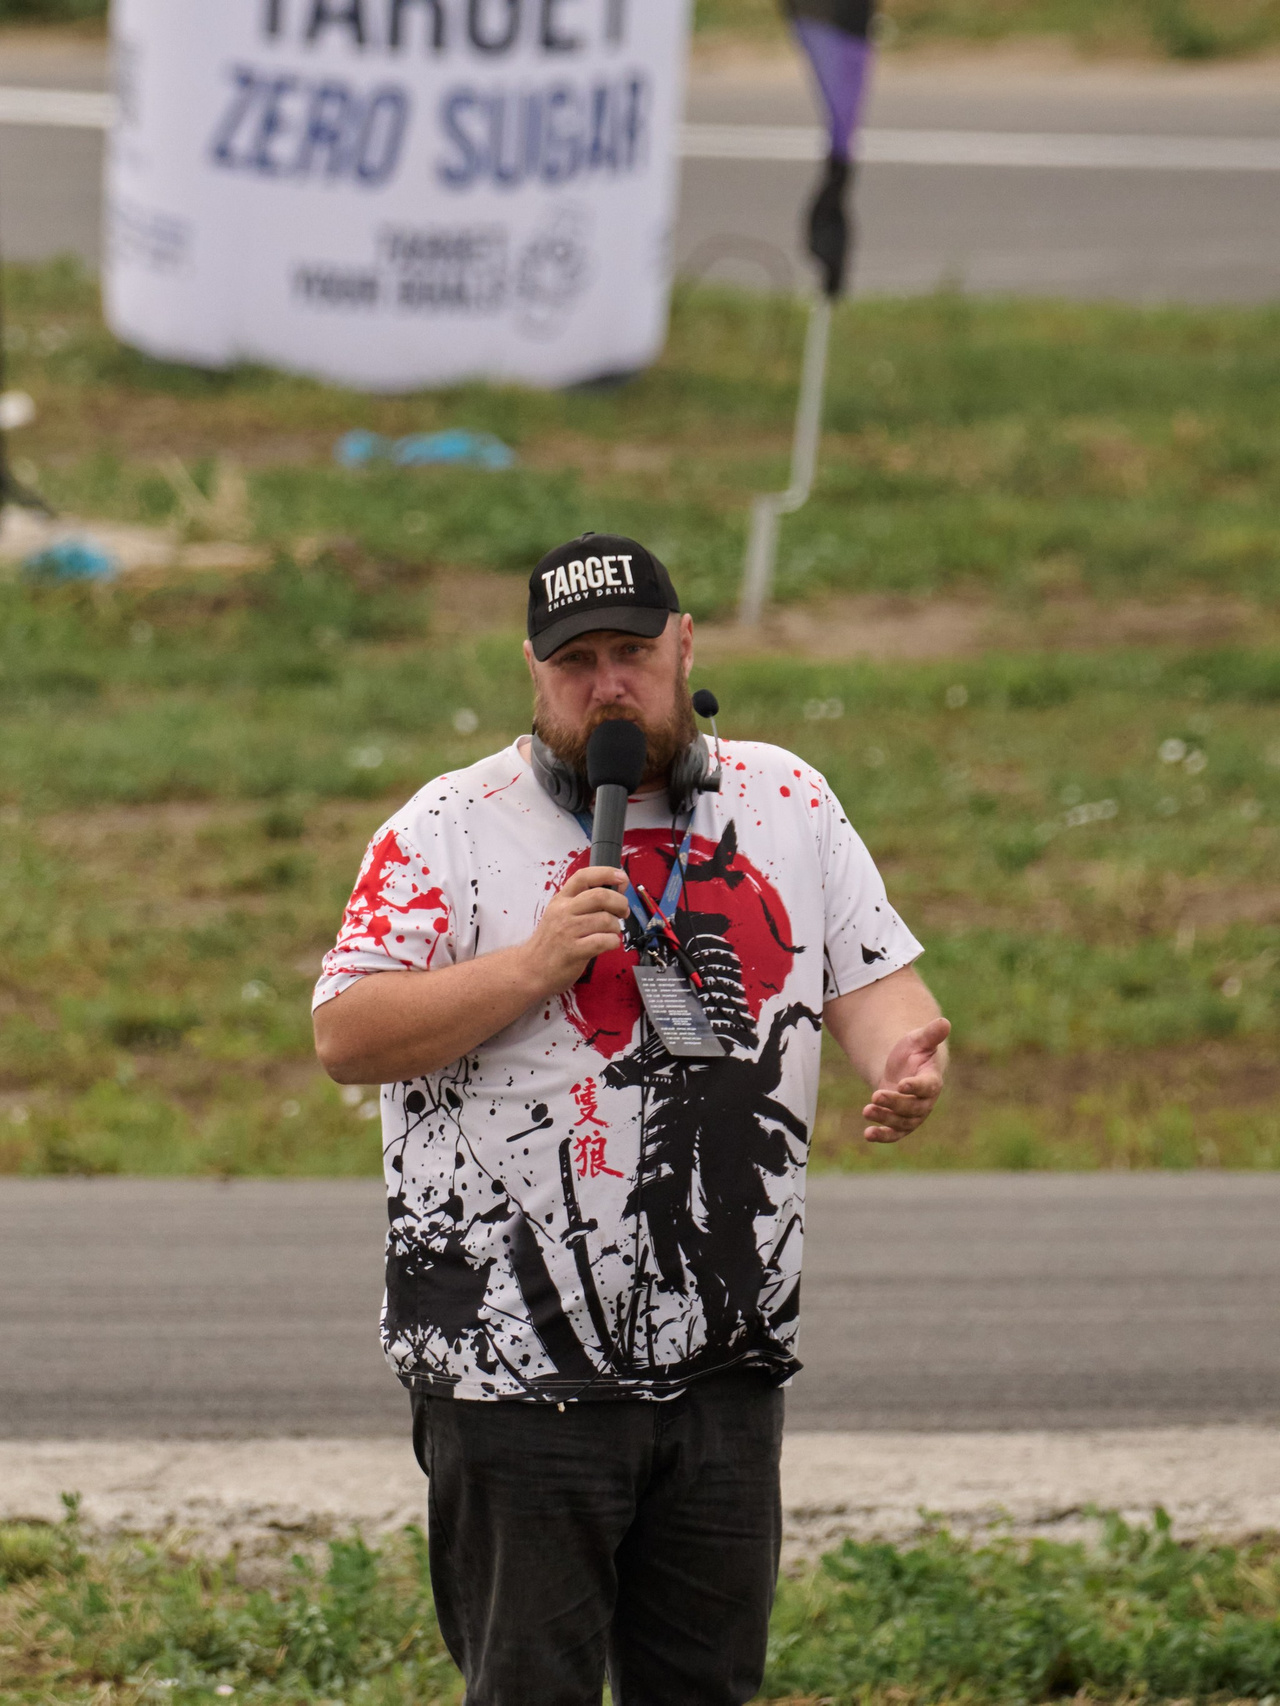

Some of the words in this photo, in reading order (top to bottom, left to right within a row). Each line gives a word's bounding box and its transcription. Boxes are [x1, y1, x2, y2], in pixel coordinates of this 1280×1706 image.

[211, 64, 410, 188] ZERO
[541, 555, 635, 603] TARGET
[548, 591, 589, 612] ENERGY
[596, 586, 635, 597] DRINK
[569, 1076, 625, 1179] 隻狼
